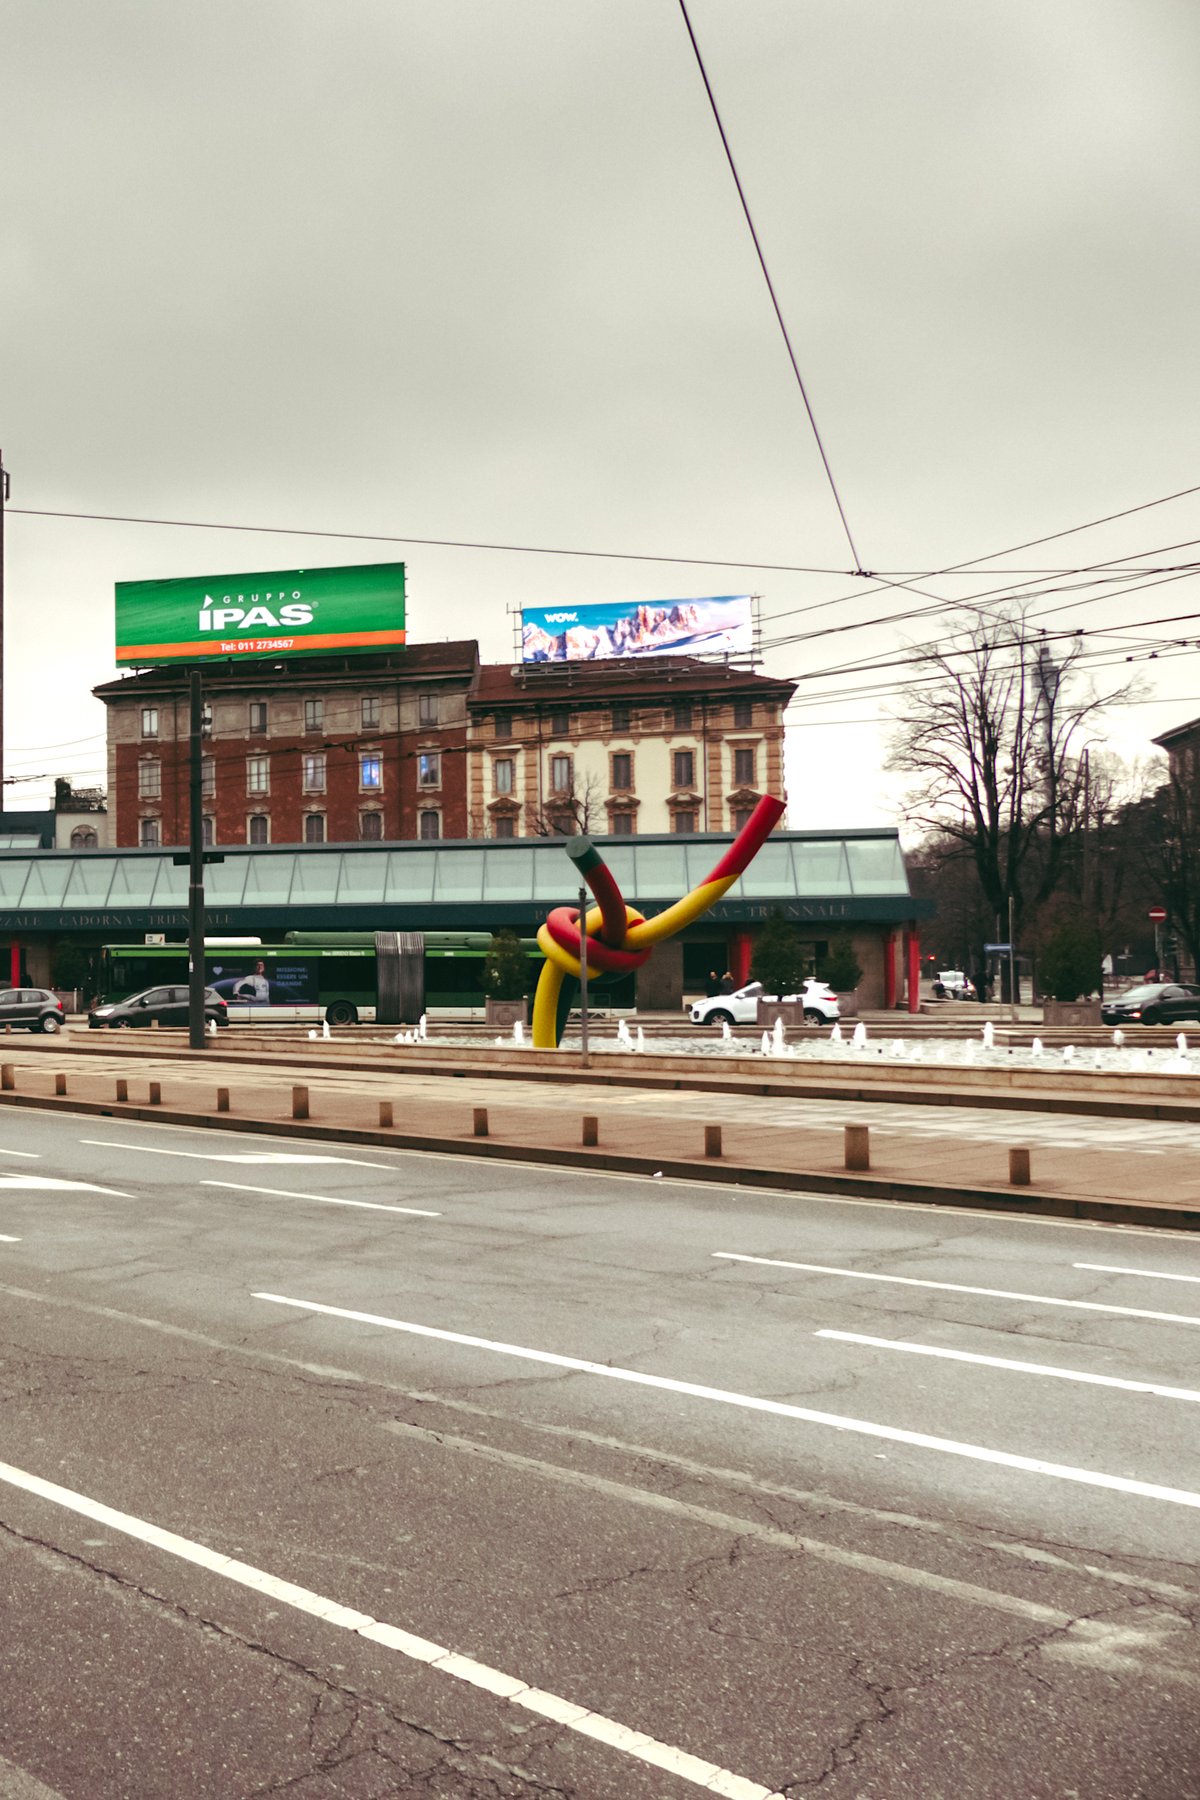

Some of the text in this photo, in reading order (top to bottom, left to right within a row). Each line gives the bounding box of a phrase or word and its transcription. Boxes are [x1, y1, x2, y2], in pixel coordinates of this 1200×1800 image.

[222, 591, 301, 604] GRUPPO
[221, 639, 294, 651] Tel: 011 2734567
[59, 914, 132, 926] CADORNA
